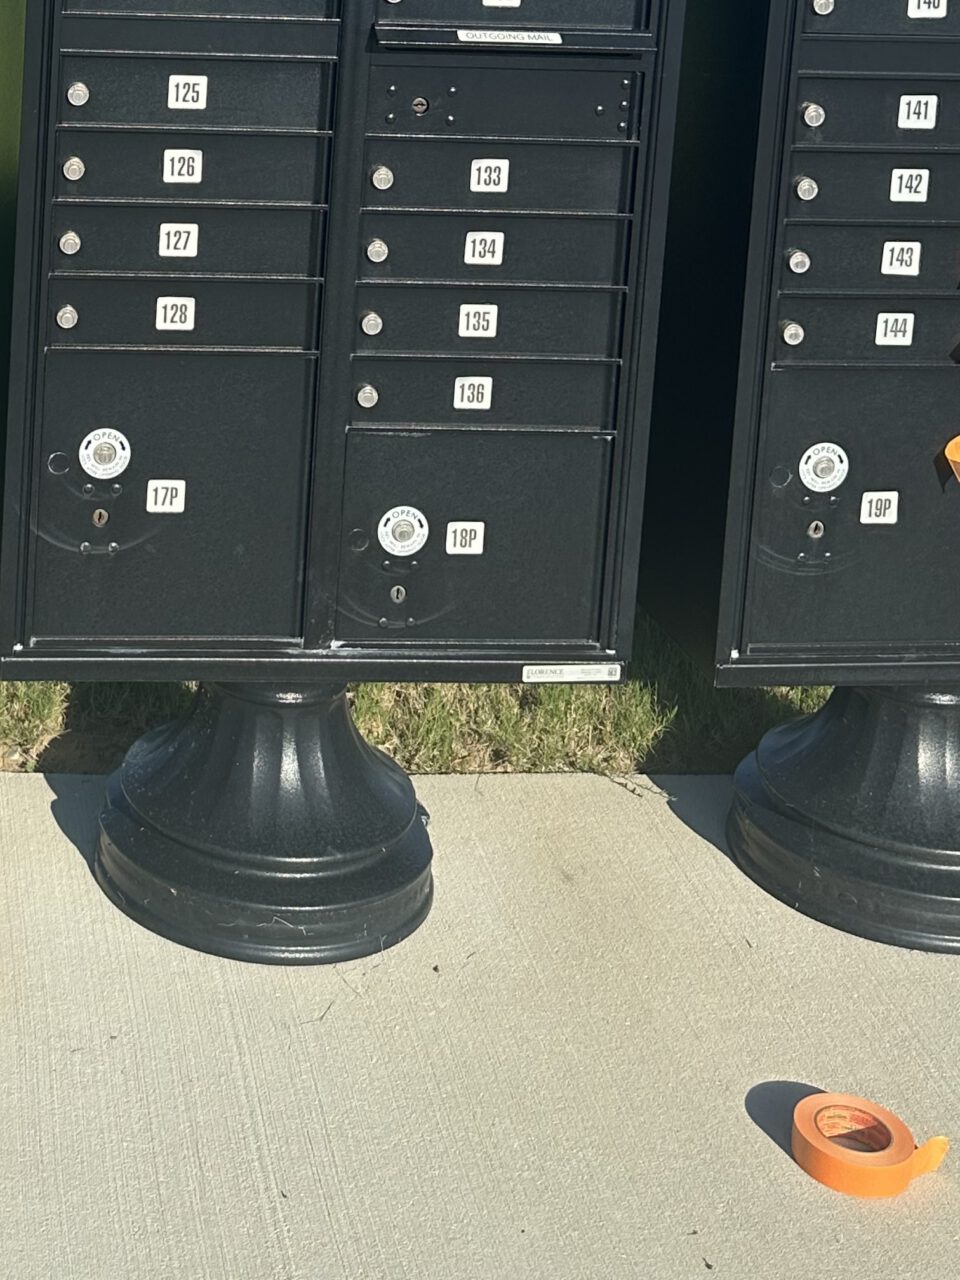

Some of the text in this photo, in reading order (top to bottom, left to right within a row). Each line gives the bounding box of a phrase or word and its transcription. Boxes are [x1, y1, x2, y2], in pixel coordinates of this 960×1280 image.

[465, 32, 553, 42] OUTGOING MAIL
[174, 82, 200, 103] 125
[905, 99, 929, 120] 141
[169, 156, 195, 177] 126
[475, 165, 502, 187] 133
[897, 173, 923, 194] 142
[165, 230, 191, 251] 127
[471, 238, 496, 259] 134
[889, 247, 914, 268] 143
[162, 303, 188, 324] 128
[465, 311, 490, 332] 135
[883, 318, 908, 338] 144
[459, 383, 485, 404] 136
[93, 432, 120, 442] OPEN
[812, 446, 838, 456] OPEN
[152, 486, 179, 506] 17P
[392, 509, 418, 520] OPEN
[867, 498, 892, 518] 19P
[452, 528, 477, 548] 18P
